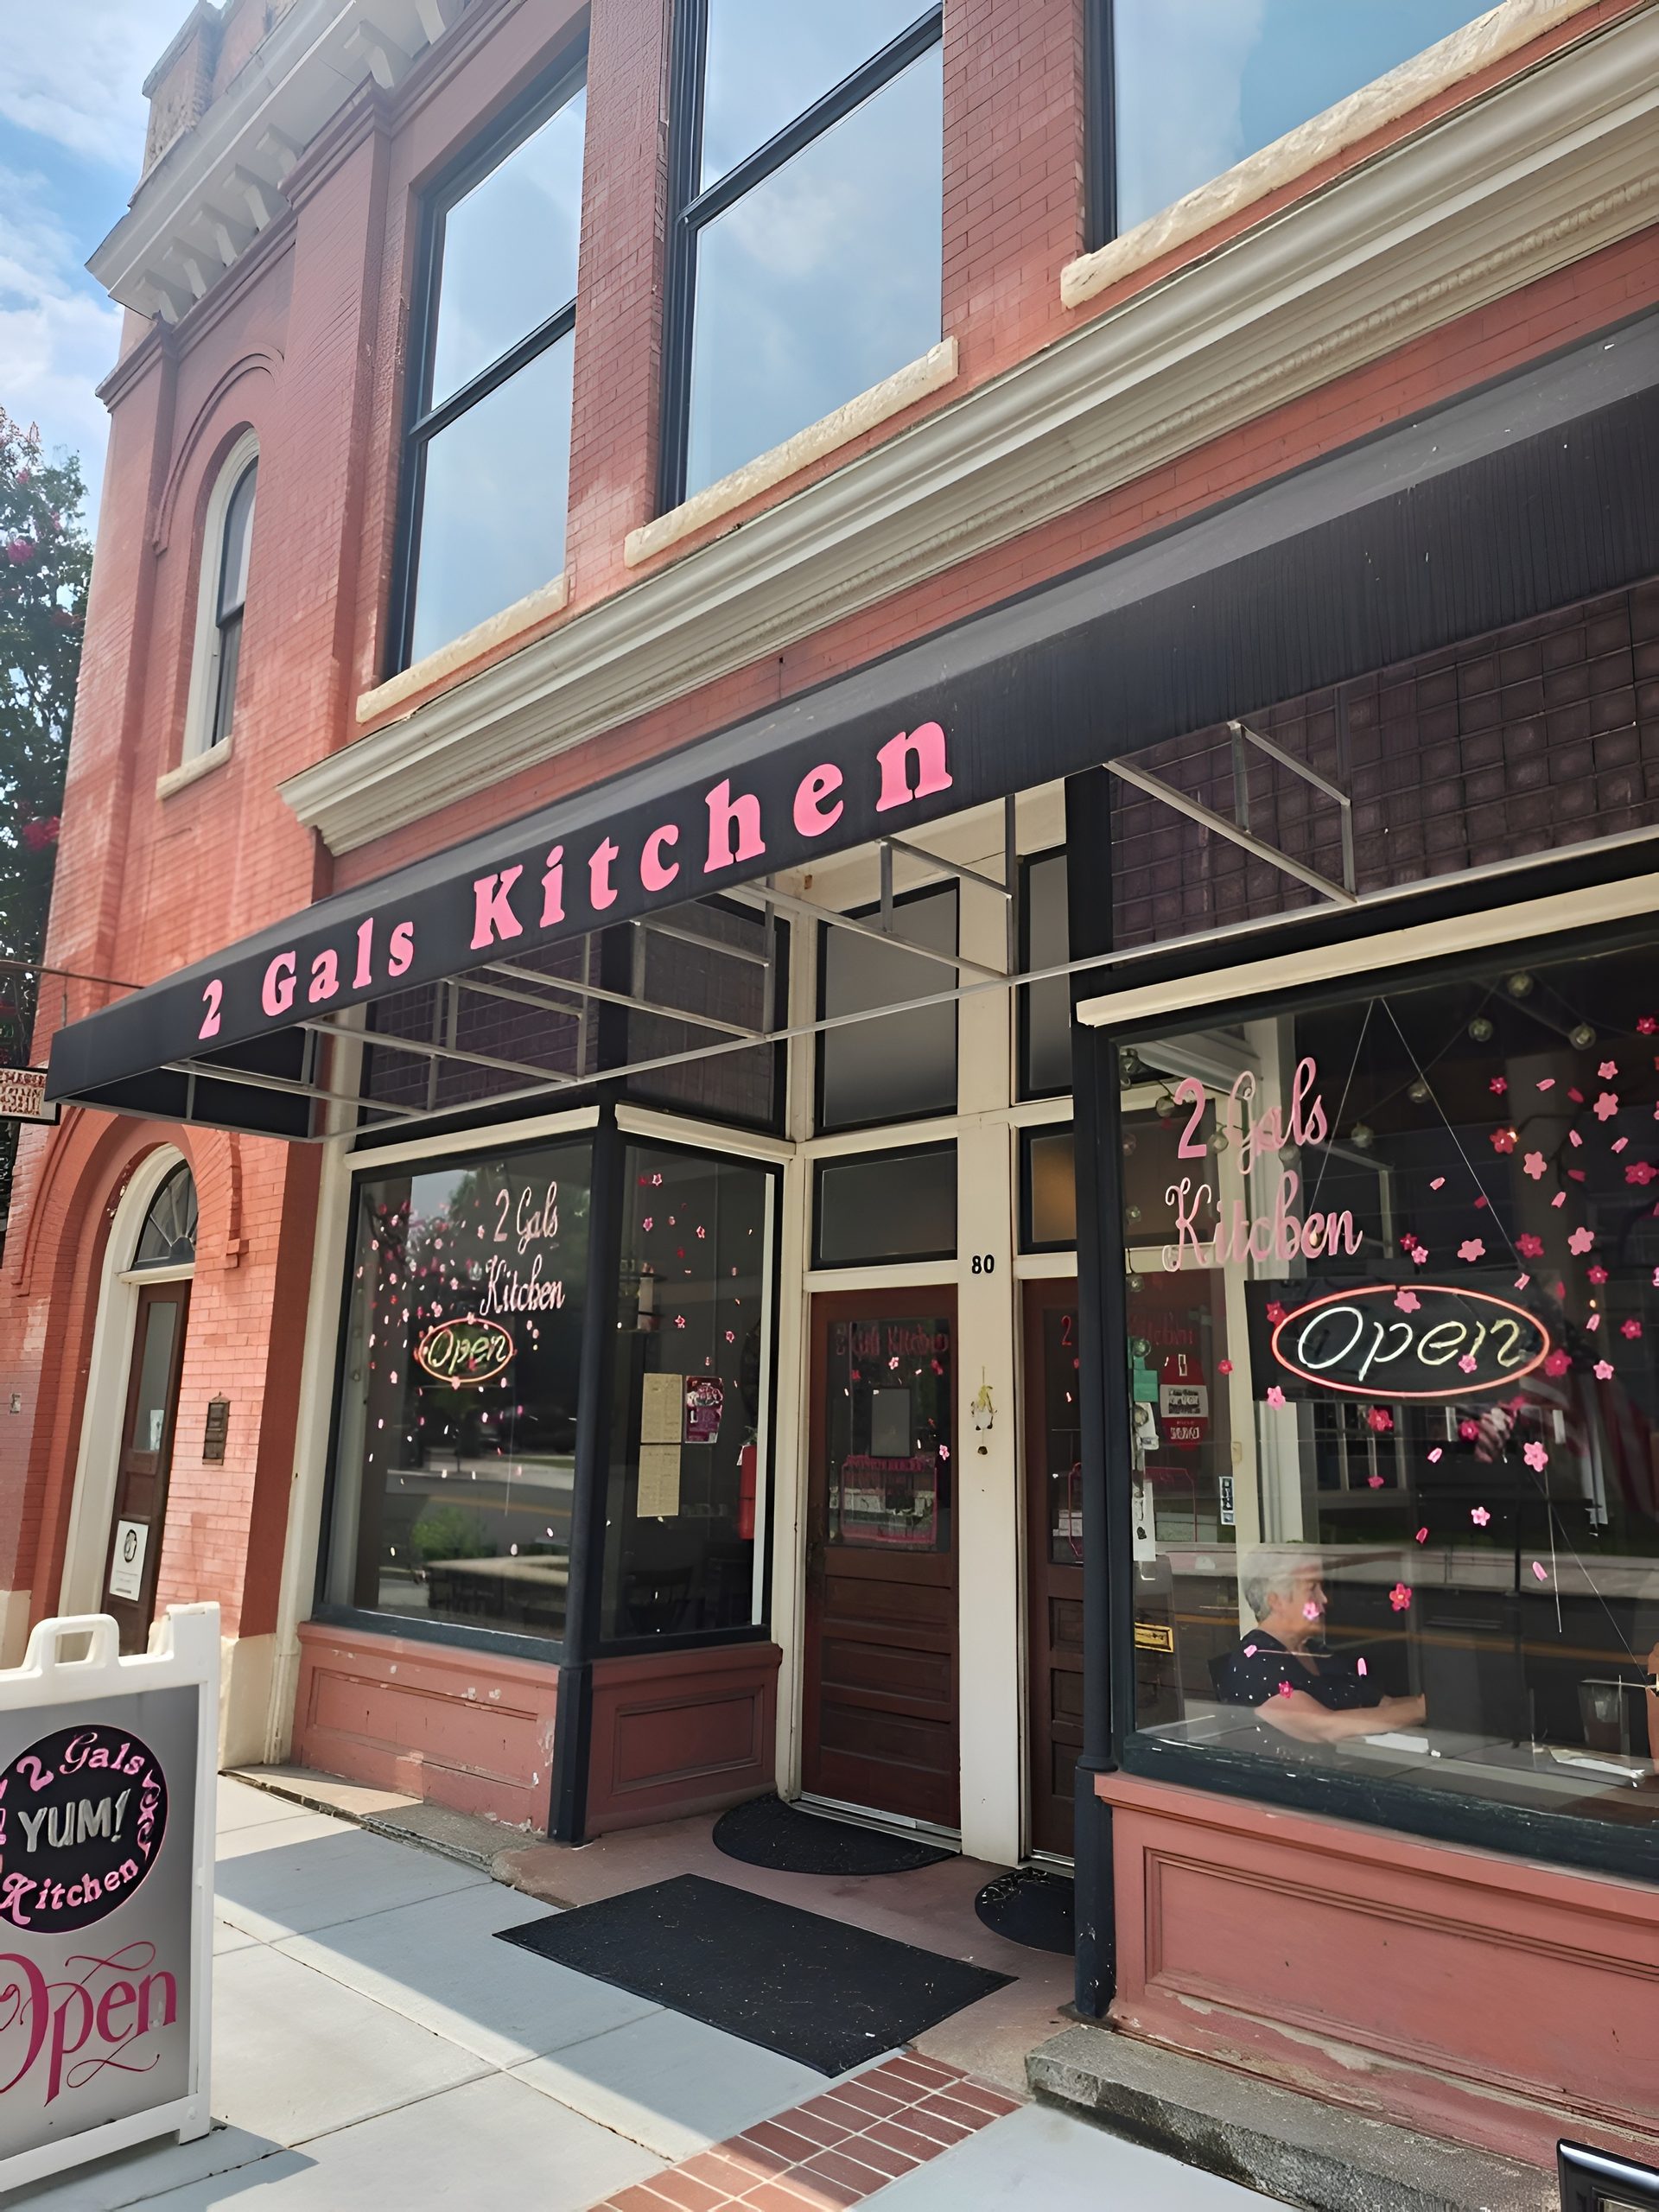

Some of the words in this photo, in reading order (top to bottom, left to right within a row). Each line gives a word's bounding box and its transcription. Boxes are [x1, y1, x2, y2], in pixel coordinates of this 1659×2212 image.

[199, 979, 223, 1039] 2
[262, 917, 414, 1018] Gals
[470, 721, 953, 950] Kitchen
[1173, 1077, 1207, 1159] 2
[1227, 1057, 1327, 1175] Gals
[493, 1189, 510, 1242] 2
[517, 1181, 559, 1255] Gals
[1162, 1170, 1363, 1272] Kitchen
[480, 1254, 565, 1316] Kitchen
[971, 1255, 995, 1274] 80
[428, 1328, 507, 1375] Open
[1061, 1315, 1072, 1345] 2
[1298, 1306, 1529, 1382] Open
[16, 1756, 54, 1792] 2
[59, 1732, 145, 1776] Gals
[17, 1789, 130, 1853] YUM!
[0, 1859, 139, 1925] Kitchen
